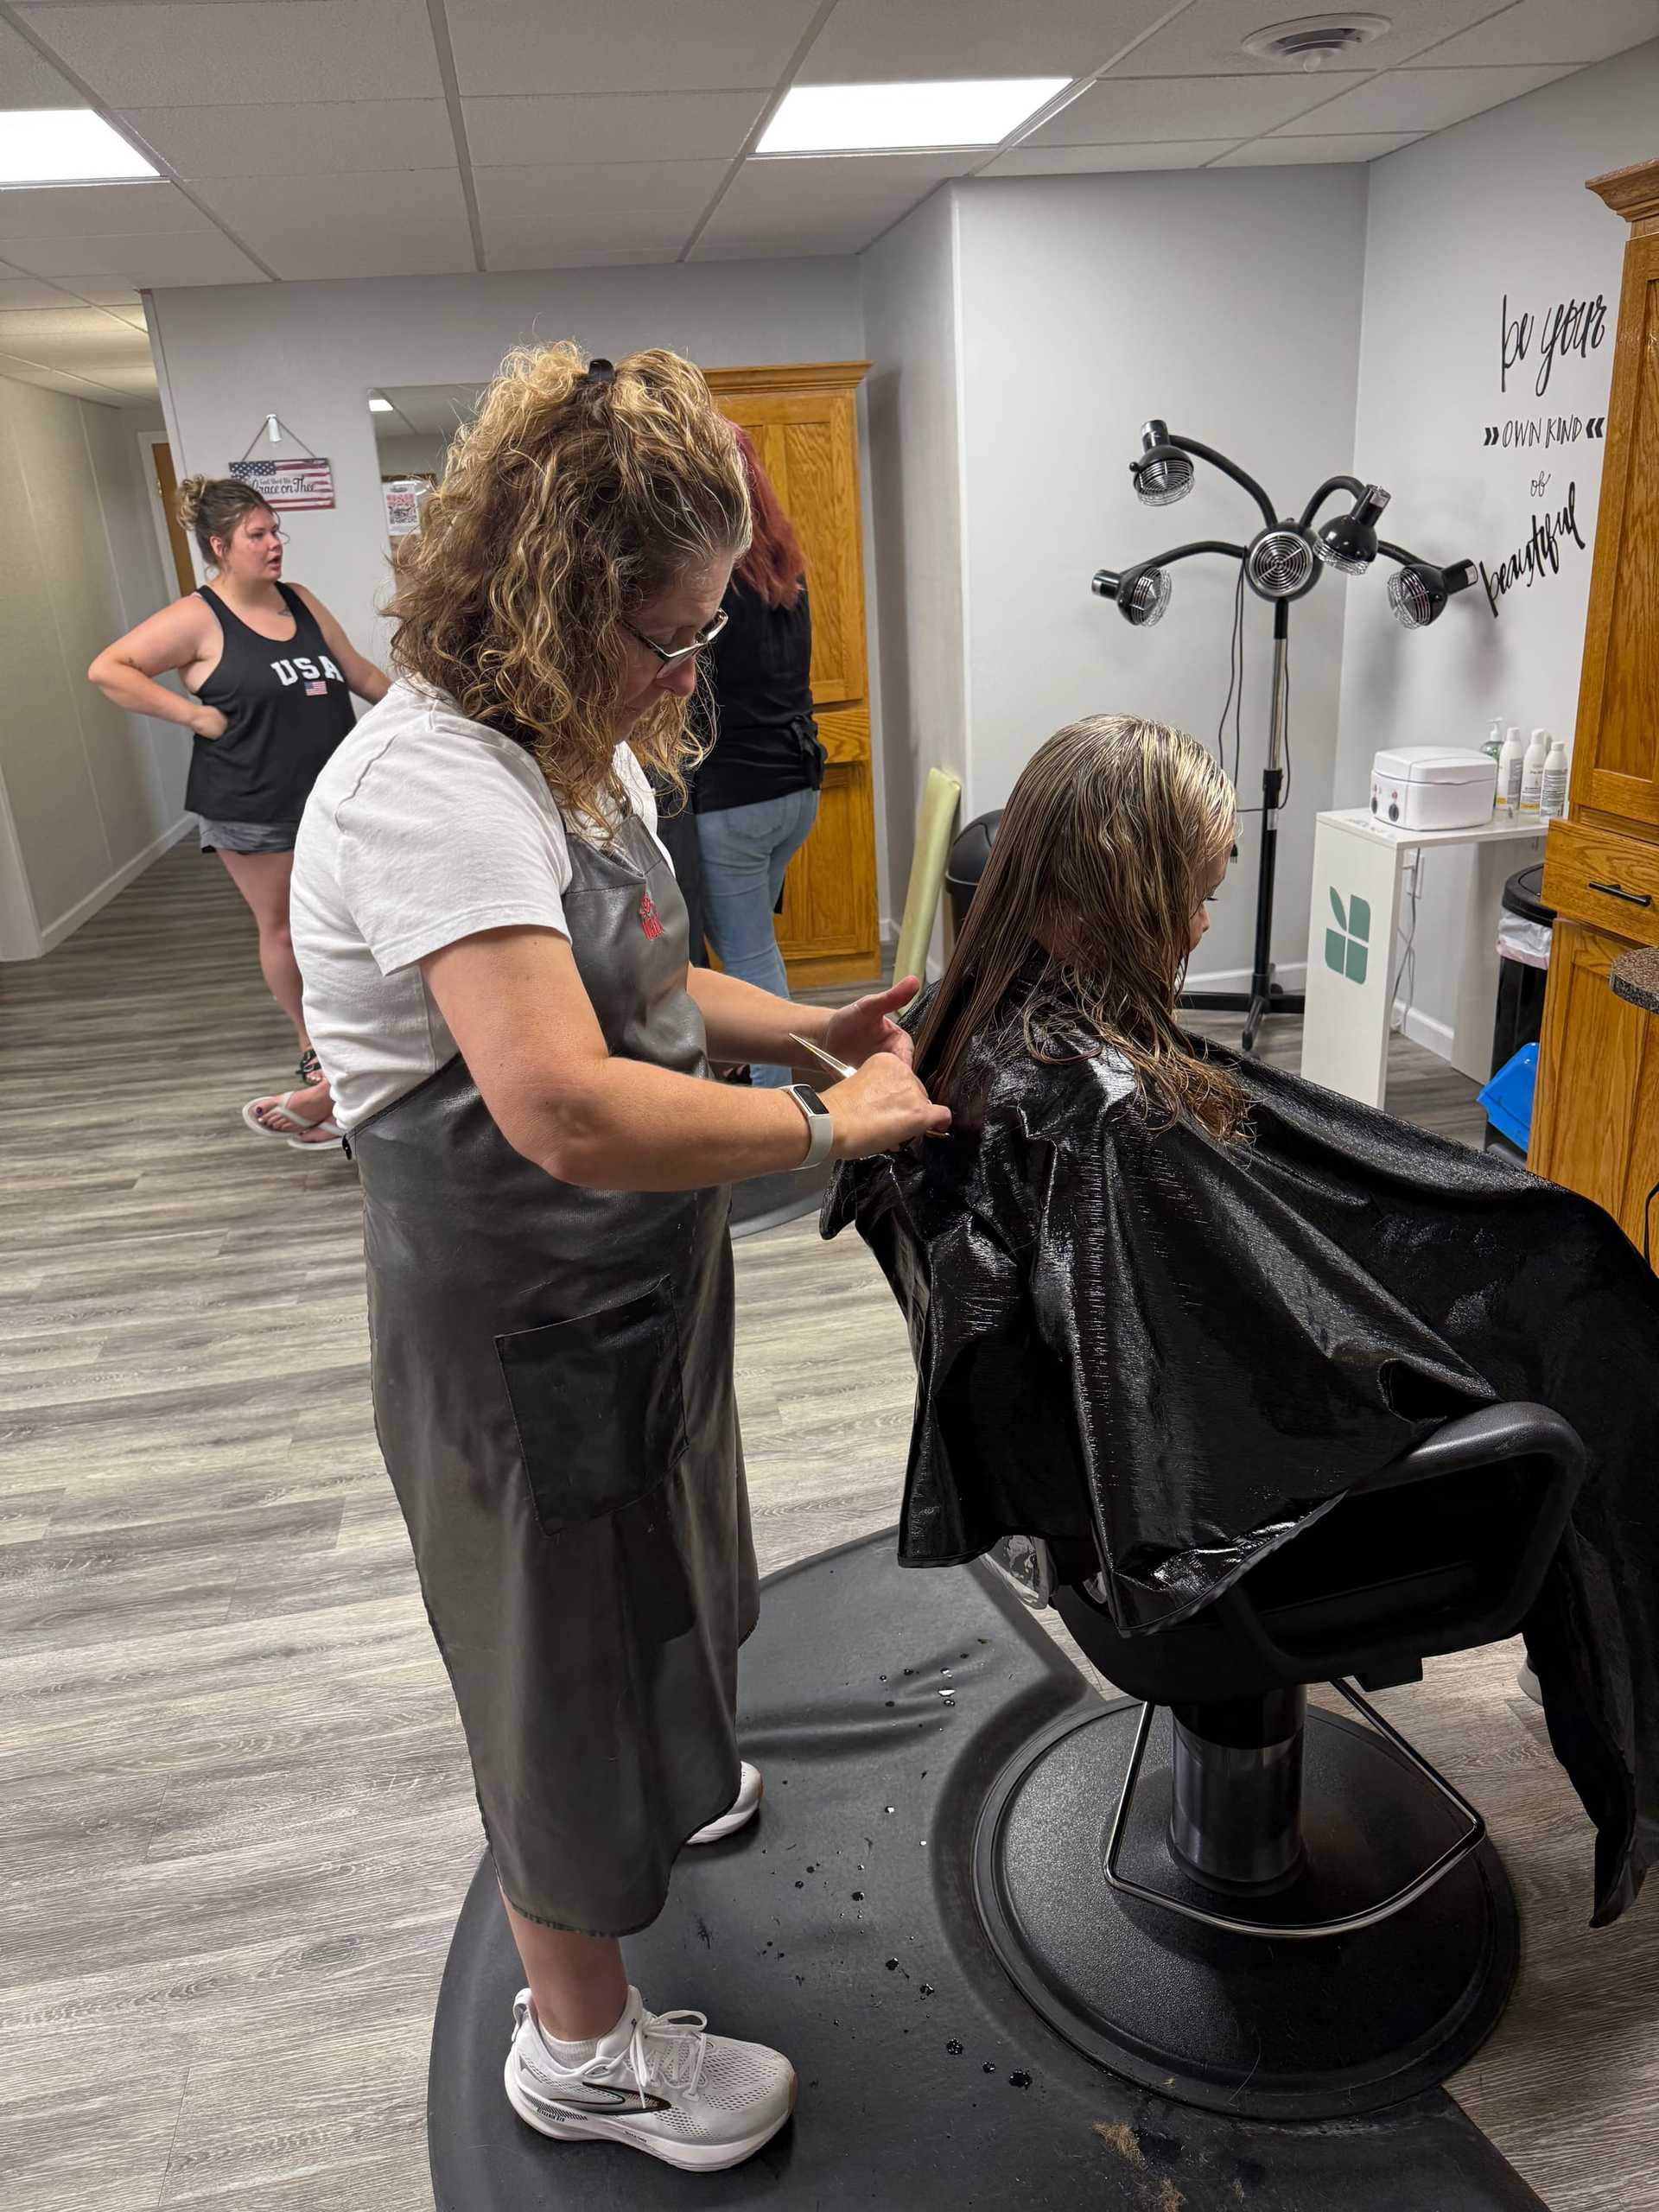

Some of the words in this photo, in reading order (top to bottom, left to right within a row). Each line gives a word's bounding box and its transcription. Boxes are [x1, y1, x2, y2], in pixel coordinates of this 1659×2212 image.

[1502, 294, 1535, 393] be
[1535, 294, 1607, 397] your
[1502, 417, 1541, 449] OWN
[1545, 414, 1583, 448] KIND
[281, 484, 293, 494] on
[1530, 470, 1551, 498] of
[1479, 480, 1586, 619] beautiful
[270, 656, 345, 686] USA
